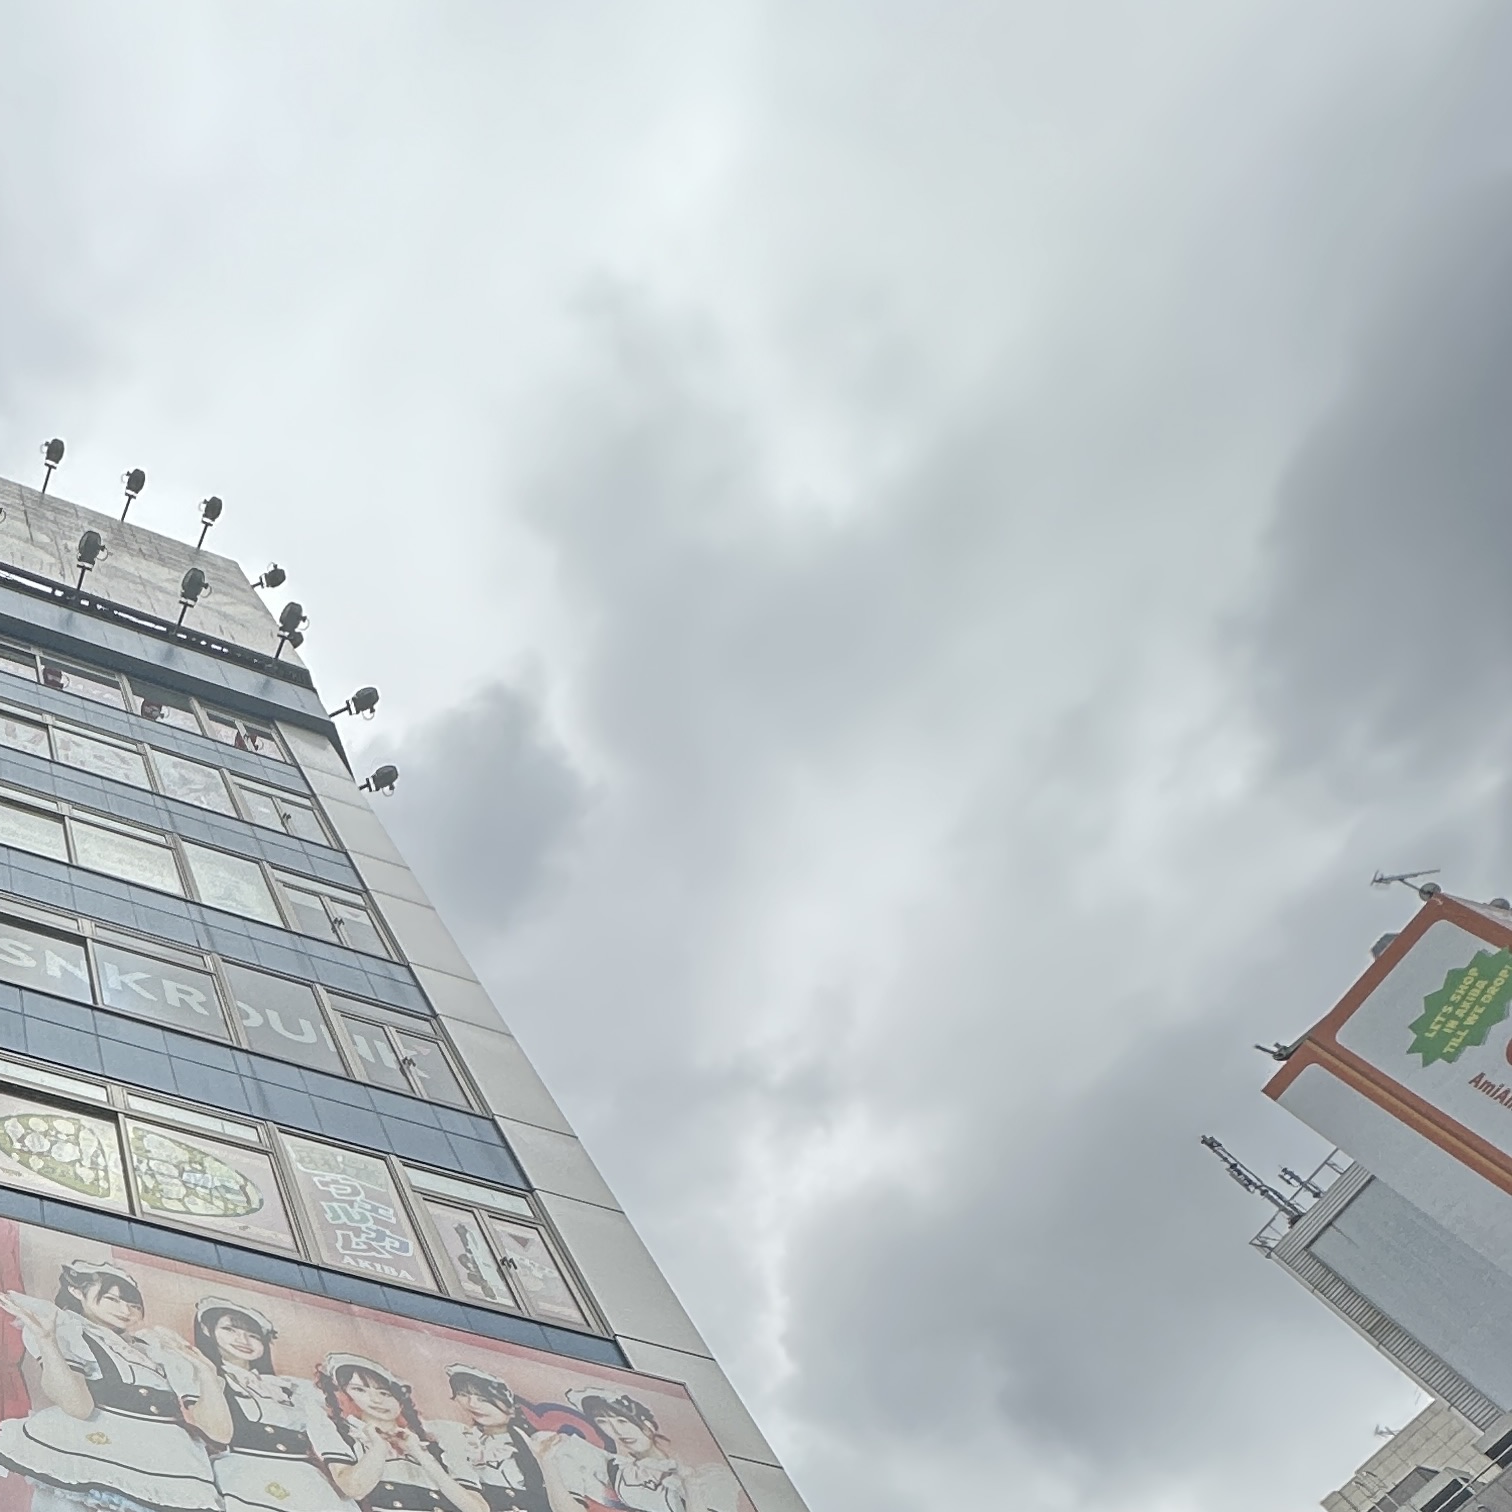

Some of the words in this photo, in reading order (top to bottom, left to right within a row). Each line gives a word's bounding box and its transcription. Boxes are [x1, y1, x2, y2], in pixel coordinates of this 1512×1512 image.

[1449, 966, 1480, 1004] SHOP
[1442, 1028, 1470, 1054] TILL
[1462, 1004, 1486, 1026] WE
[341, 1255, 416, 1282] AKIBA
